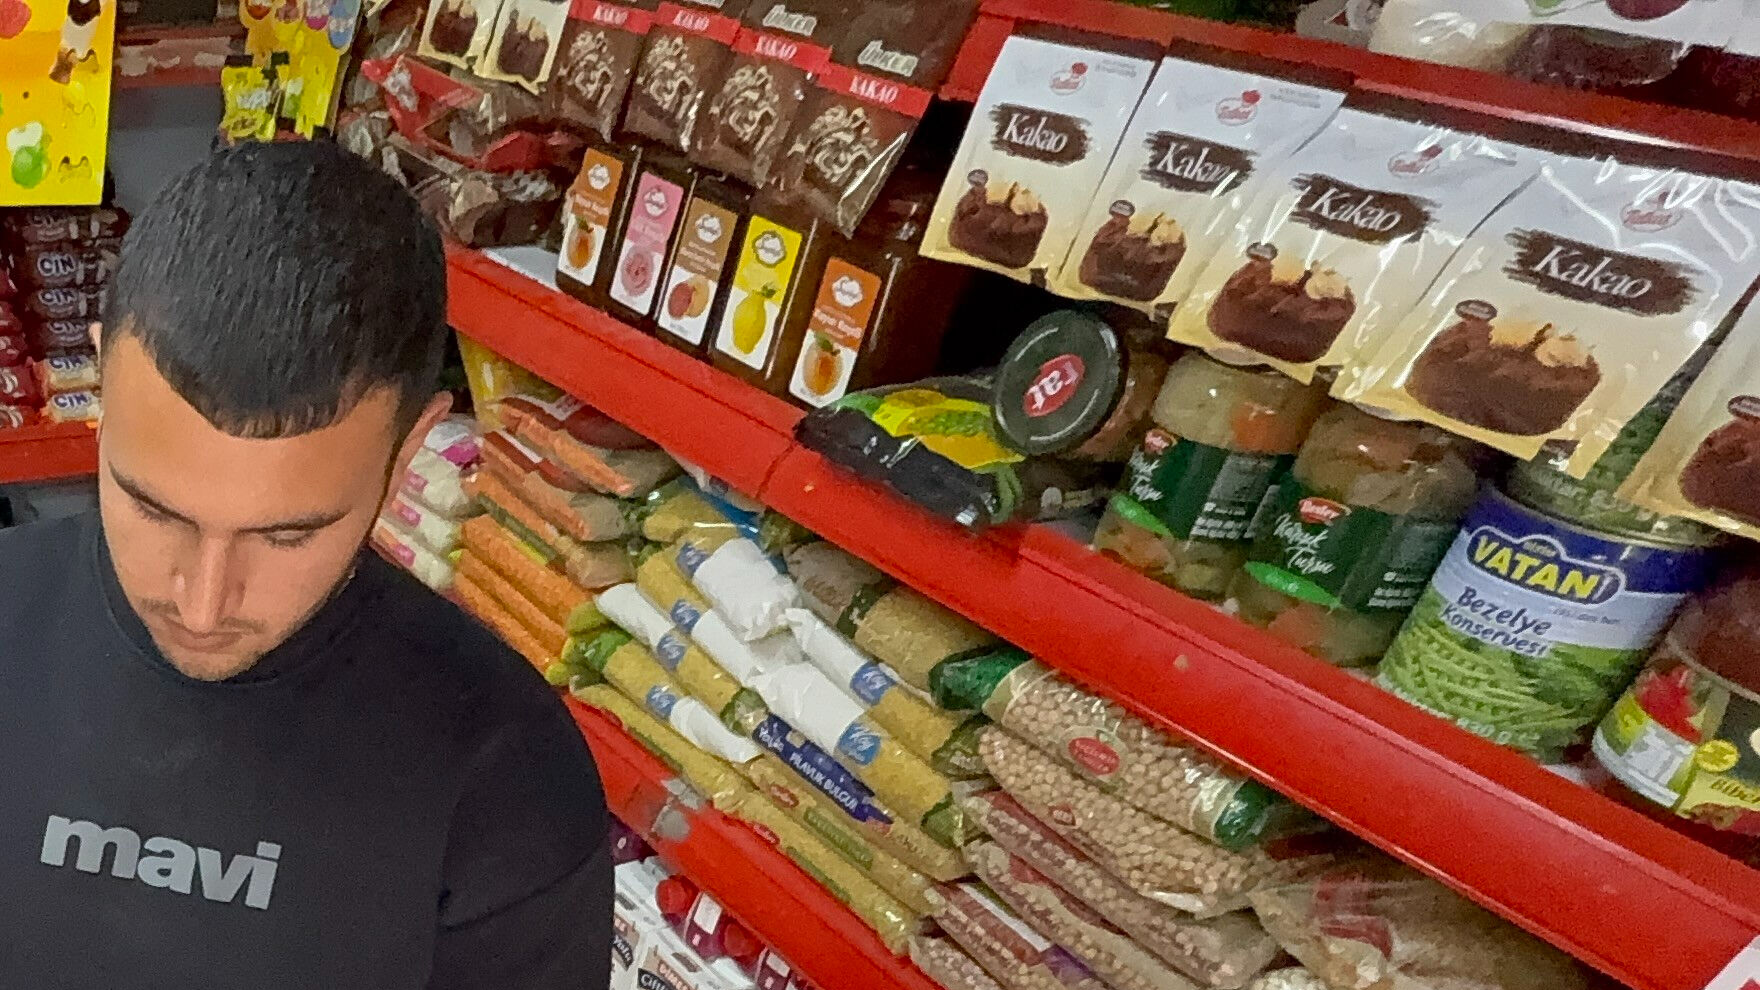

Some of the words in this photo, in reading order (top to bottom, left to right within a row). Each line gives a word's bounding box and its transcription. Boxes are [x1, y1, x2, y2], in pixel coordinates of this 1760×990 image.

[1002, 113, 1069, 153] Kakao
[1311, 187, 1403, 232] Kakao
[1533, 244, 1653, 300] Kakao
[1473, 534, 1600, 599] VATAN
[1442, 603, 1548, 656] Konservesi
[1457, 585, 1553, 636] Bezelye
[40, 814, 282, 910] mavi
